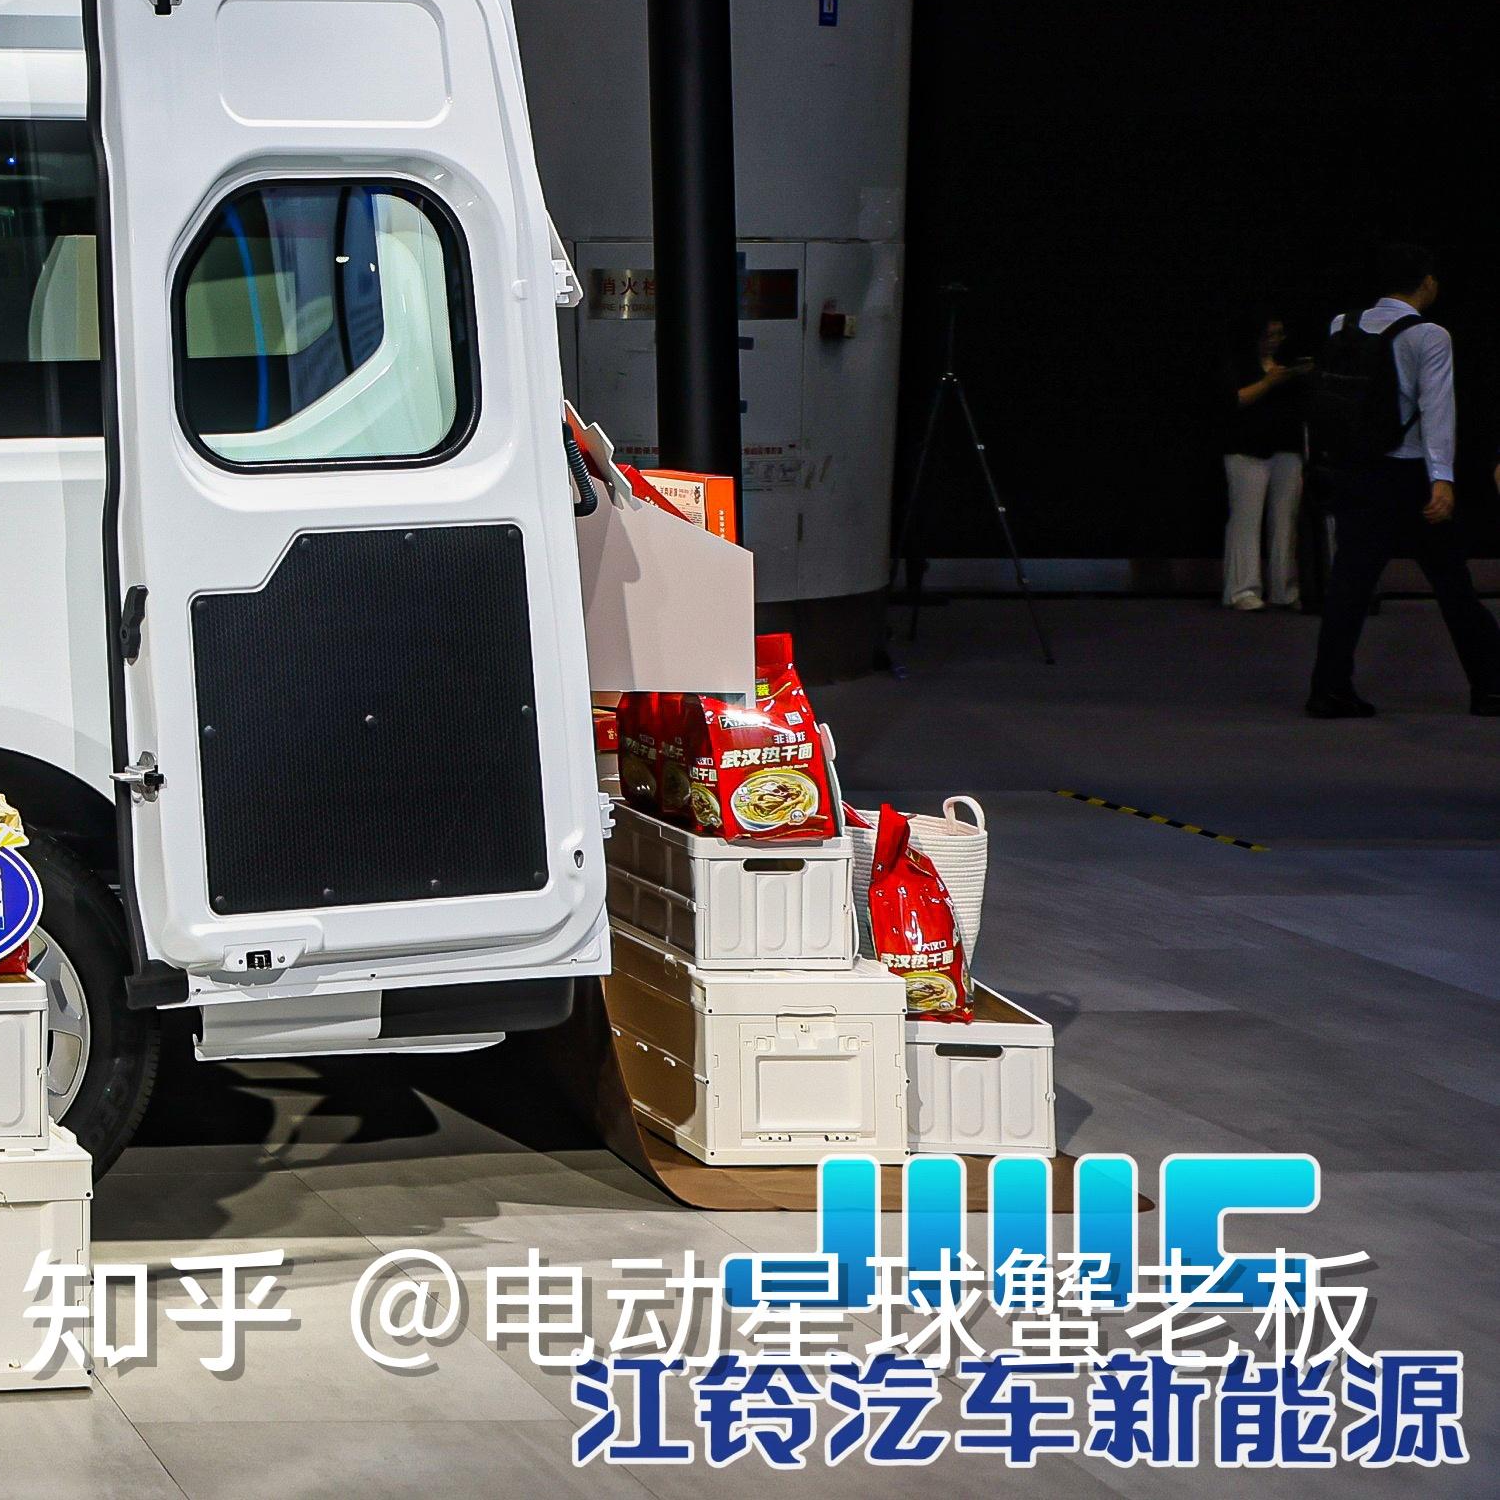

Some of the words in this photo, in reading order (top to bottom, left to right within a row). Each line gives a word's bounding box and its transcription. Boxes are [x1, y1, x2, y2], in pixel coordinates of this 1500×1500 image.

[719, 742, 813, 769] 武汉热干面
